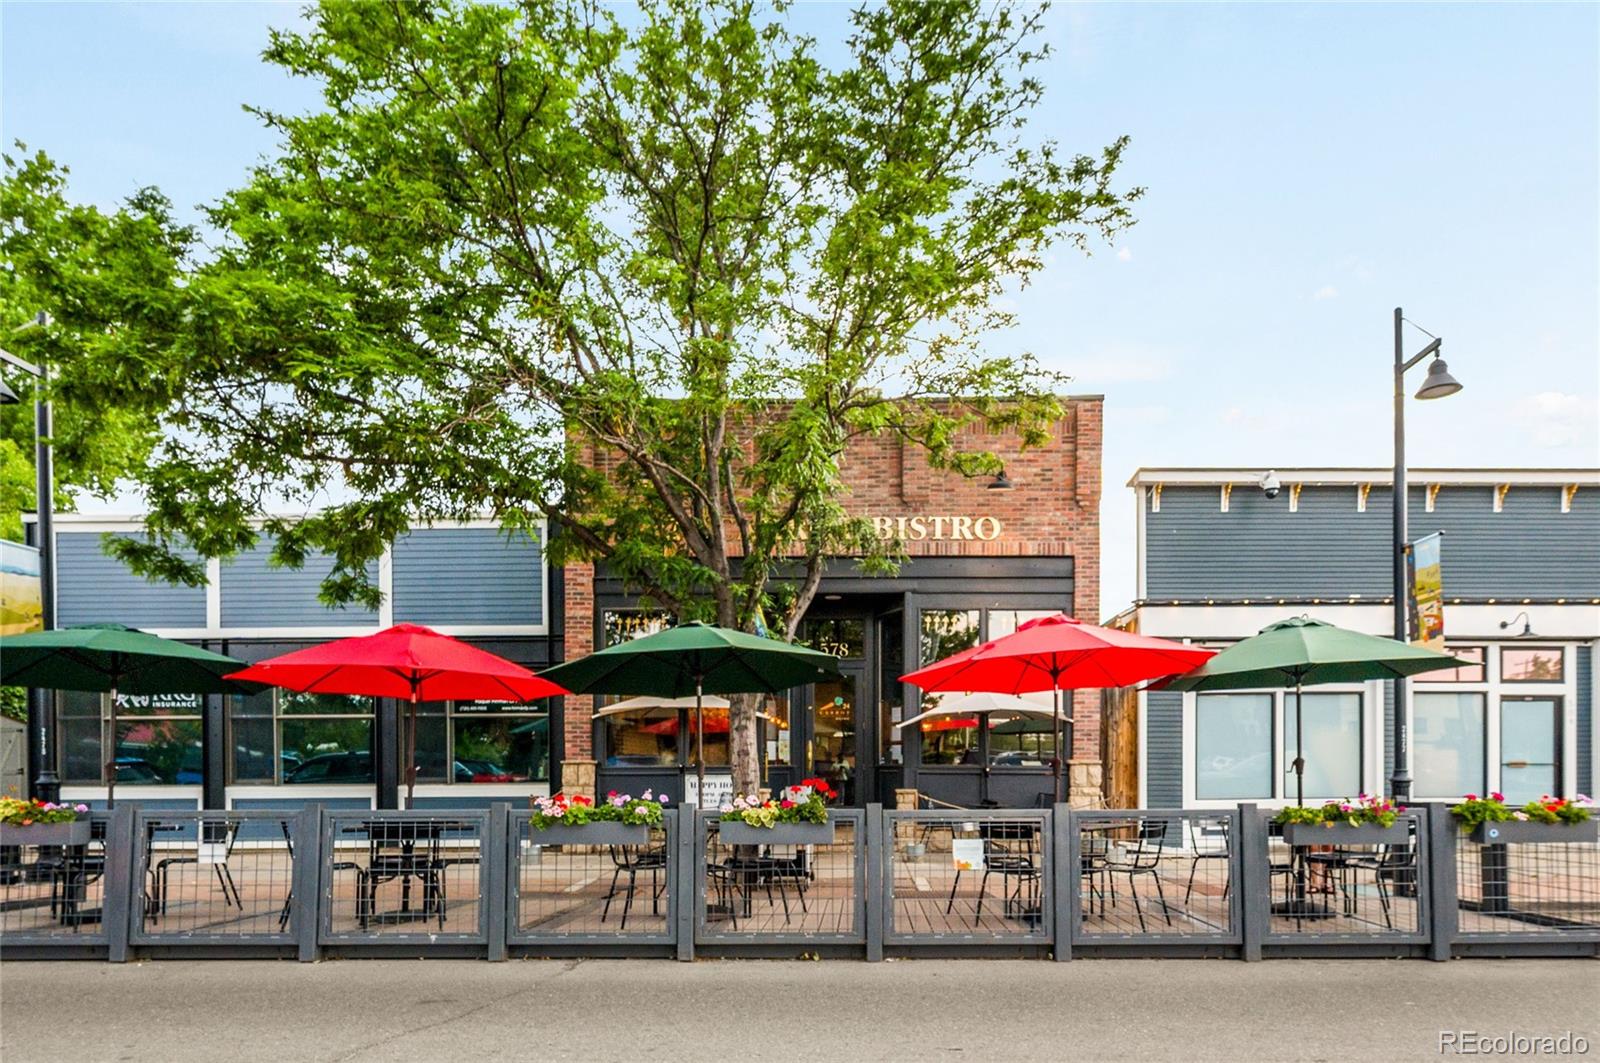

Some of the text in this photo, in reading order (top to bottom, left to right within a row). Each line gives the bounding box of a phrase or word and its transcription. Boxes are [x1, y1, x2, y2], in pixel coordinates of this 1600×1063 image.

[872, 515, 1001, 541] BISTRO
[820, 642, 849, 657] 578
[690, 781, 717, 789] HPPY
